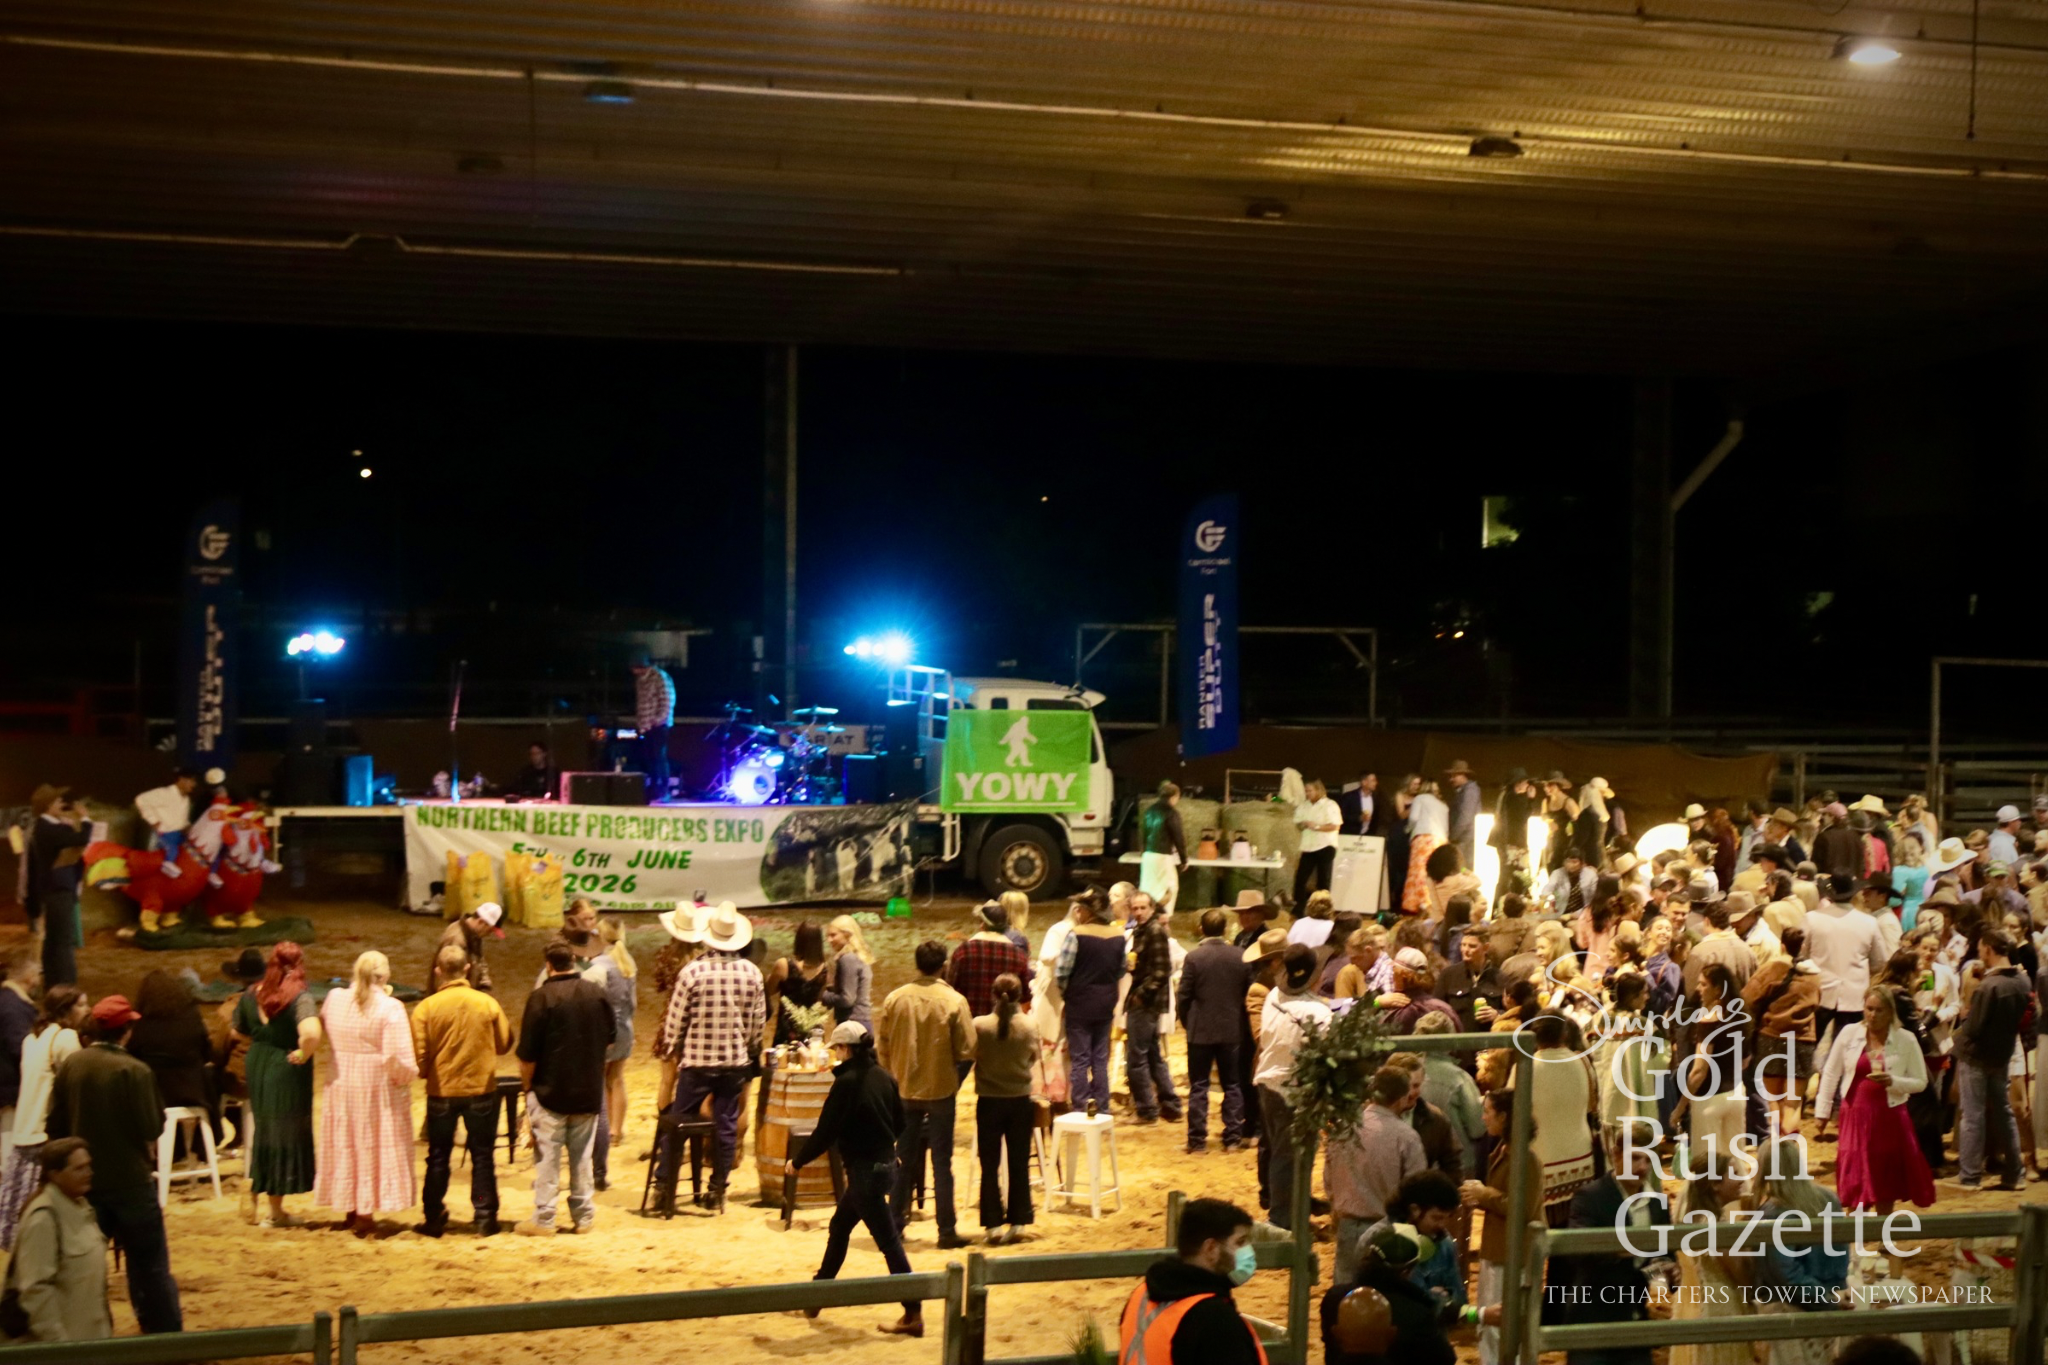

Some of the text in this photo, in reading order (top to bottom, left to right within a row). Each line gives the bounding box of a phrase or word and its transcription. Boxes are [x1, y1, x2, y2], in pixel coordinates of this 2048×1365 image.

[955, 772, 1078, 801] YOWY
[417, 806, 764, 842] NORTHERN BEEF PRODUCERS EXPO
[572, 848, 611, 868] 6TH
[627, 850, 692, 869] JUNE
[563, 873, 637, 893] 2026
